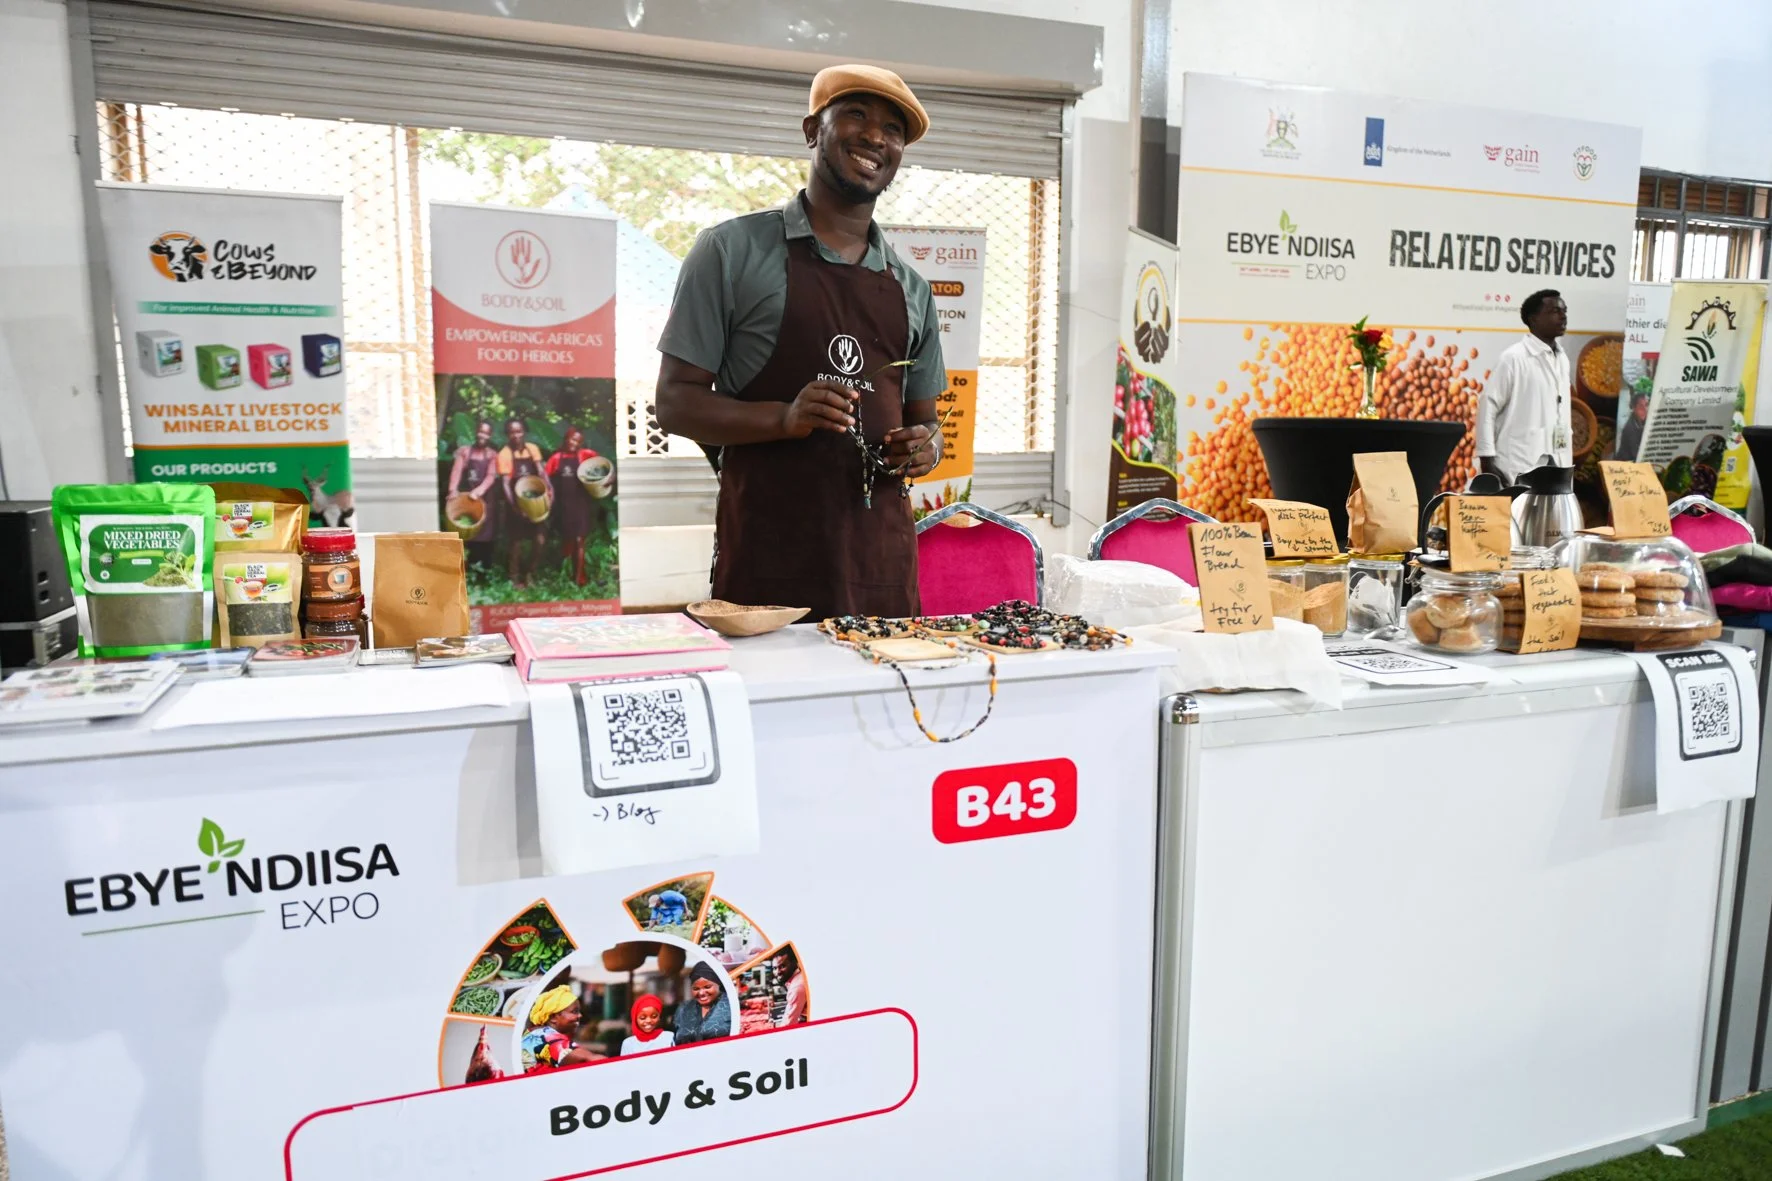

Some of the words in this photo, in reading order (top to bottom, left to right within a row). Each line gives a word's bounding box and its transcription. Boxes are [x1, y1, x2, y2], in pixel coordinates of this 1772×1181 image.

[1504, 144, 1539, 167] gain
[1227, 232, 1279, 255] EBYE
[935, 243, 978, 265] gain
[1389, 229, 1501, 272] RELATED
[1506, 237, 1616, 279] SERVICES
[1305, 263, 1346, 281] EXPO
[937, 309, 966, 319] TION
[445, 327, 543, 345] EMPOWERING
[477, 348, 519, 362] FOOD
[522, 349, 574, 364] HEROES
[953, 376, 968, 386] to
[1681, 365, 1718, 382] SAWA
[144, 402, 236, 418] WINSALT
[240, 402, 342, 416] LIVESTOCK
[164, 419, 251, 433] MINERAL
[255, 418, 330, 432] BLOCKS
[151, 463, 187, 477] OUR
[190, 461, 278, 475] PRODUCTS
[104, 531, 143, 540] MIXED
[145, 530, 180, 540] DRIED
[1200, 527, 1232, 542] 100%
[104, 540, 180, 549] VEGETABLES
[1204, 558, 1244, 572] Bread
[1217, 617, 1243, 628] Free
[1664, 655, 1702, 668] SCAN
[1703, 653, 1724, 664] ME
[956, 777, 1056, 828] B43
[616, 803, 662, 825] Blog
[64, 864, 204, 917] EBYE
[226, 843, 400, 897] NDIISA
[280, 891, 380, 930] EXPO
[549, 1090, 671, 1137] Body
[683, 1079, 716, 1109] &
[727, 1057, 809, 1101] Soil
